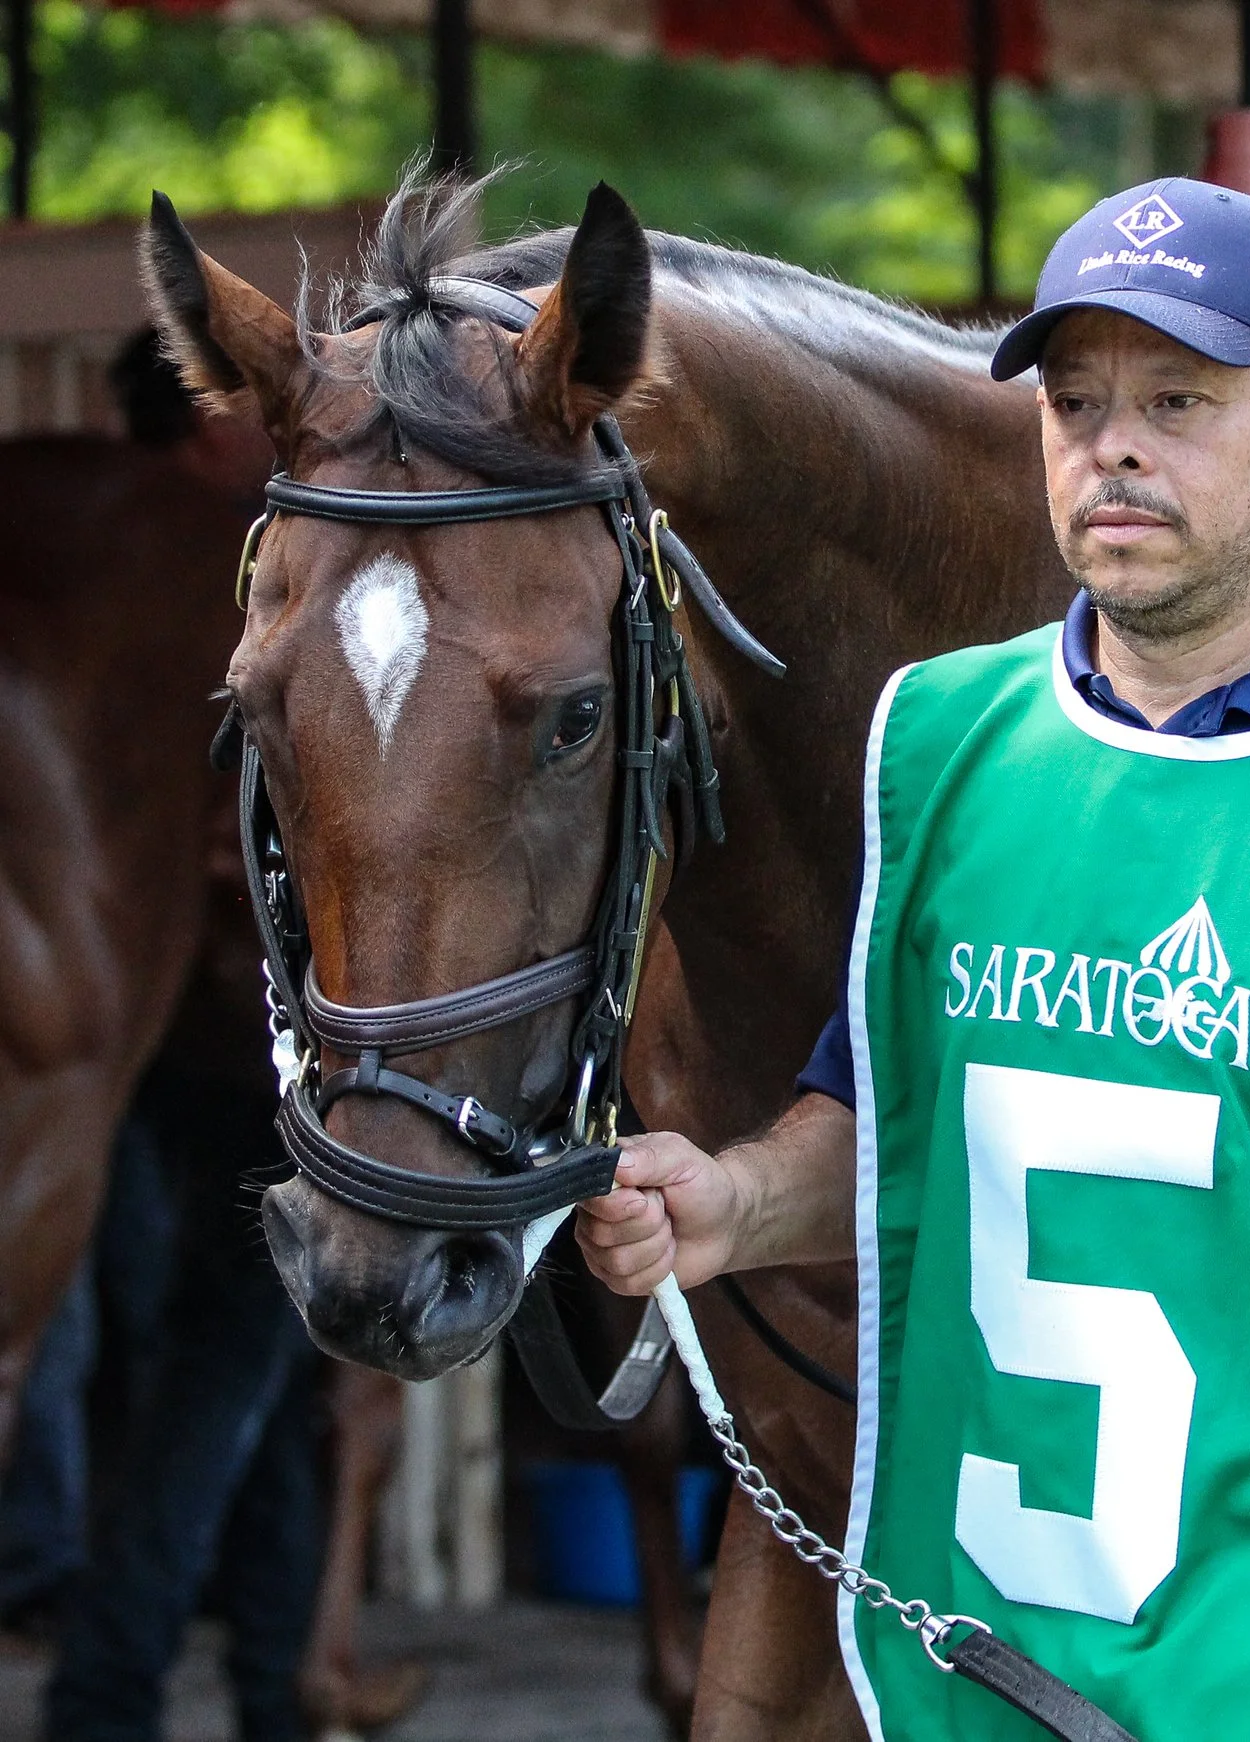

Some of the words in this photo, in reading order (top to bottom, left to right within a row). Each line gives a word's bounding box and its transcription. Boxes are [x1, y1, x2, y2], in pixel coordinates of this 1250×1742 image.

[1127, 211, 1166, 230] LR
[1114, 249, 1150, 265] Rice
[1150, 249, 1206, 279] Racing
[954, 1062, 1222, 1625] 5
